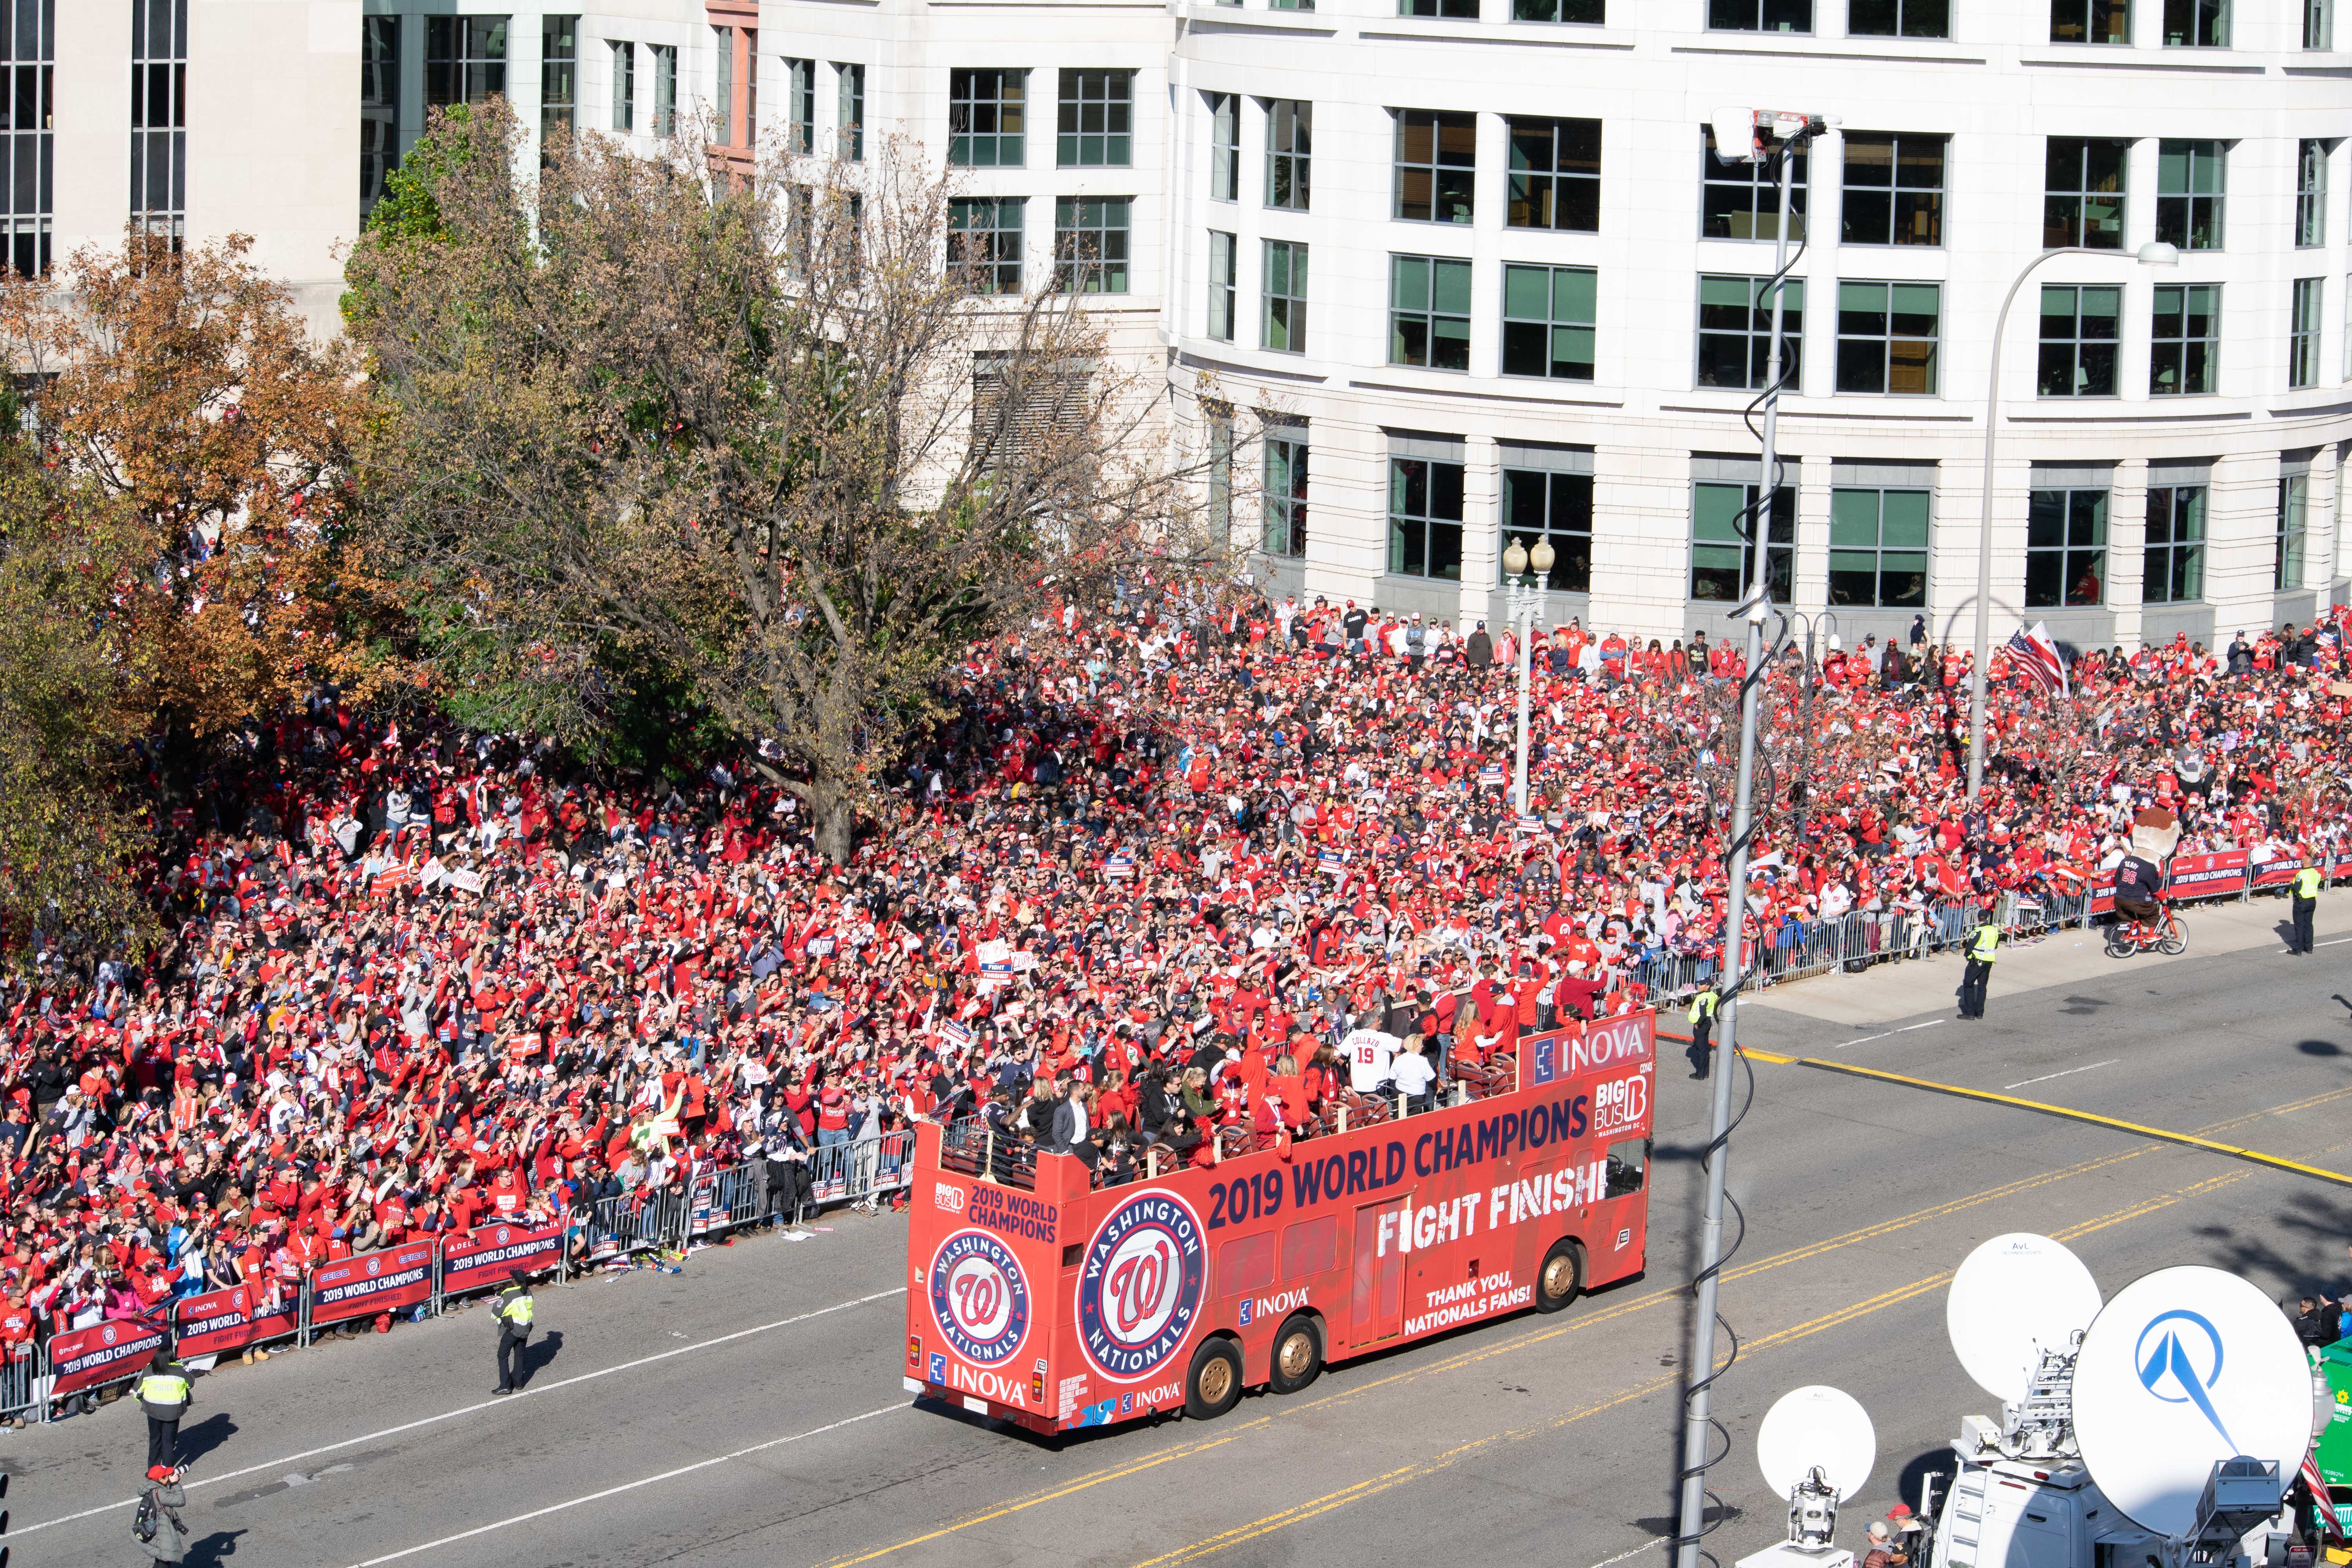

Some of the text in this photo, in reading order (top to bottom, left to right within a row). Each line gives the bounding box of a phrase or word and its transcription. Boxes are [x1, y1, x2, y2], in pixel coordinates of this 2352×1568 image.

[1319, 860, 1340, 869] FINISHED
[2261, 861, 2294, 873] 2019 WORLD
[457, 873, 481, 889] CLUTCH
[2122, 868, 2138, 885] 26
[2176, 867, 2242, 884] 2019 WORLD CHAMPIONS
[2096, 888, 2109, 898] 2019
[808, 939, 835, 948] AND NOW
[944, 1024, 967, 1042] FINISHED
[950, 1022, 964, 1032] FIGHT
[1352, 1036, 1380, 1047] COLLAZO
[1563, 1024, 1644, 1073] INOVA
[1357, 1047, 1374, 1064] 19
[1595, 1080, 1625, 1108] BIG
[1594, 1103, 1624, 1130] BUS
[1598, 1123, 1632, 1138] WASHINGTON
[1207, 1095, 1587, 1230] 2019 WORLD CHAMPIONS
[935, 1182, 953, 1196] BIG
[935, 1194, 951, 1207] BUS
[971, 1185, 1058, 1223] 2019 WORLD
[535, 1221, 559, 1232] DELTA
[969, 1205, 1056, 1244] CHAMPIONS
[1377, 1192, 1481, 1258] FIGHT
[457, 1238, 480, 1250] DELTA
[1087, 1201, 1198, 1279] WASHINGTON
[398, 1250, 427, 1264] GEICO
[453, 1238, 555, 1271] 2019 WORLD CHAMPIONS
[478, 1267, 497, 1279] FIGHT
[936, 1237, 1024, 1296] WASHINGTON
[320, 1269, 349, 1283] GEICO
[323, 1268, 423, 1303] 2019 WORLD CHAMPIONS
[1426, 1270, 1512, 1308] THANK YOU,
[195, 1301, 217, 1313] INOVA
[348, 1299, 368, 1311] FIGHT
[1256, 1288, 1308, 1319] INOVA
[1405, 1285, 1530, 1336] NATIONALS FANS!
[187, 1321, 208, 1336] 2019
[208, 1313, 241, 1333] WORLD
[213, 1332, 233, 1344] FIGHT
[939, 1310, 1018, 1359] NATIONALS
[1089, 1306, 1190, 1370] NATIONALS
[63, 1342, 84, 1354] PNCBANK
[63, 1335, 163, 1375] 2019 WORLD CHAMPIONS
[85, 1368, 105, 1381] FIGHT
[102, 1387, 118, 1398] FIGHT
[953, 1363, 1025, 1407] INOVA
[1136, 1384, 1180, 1407] INOVA
[2323, 1469, 2344, 1478] 10208294
